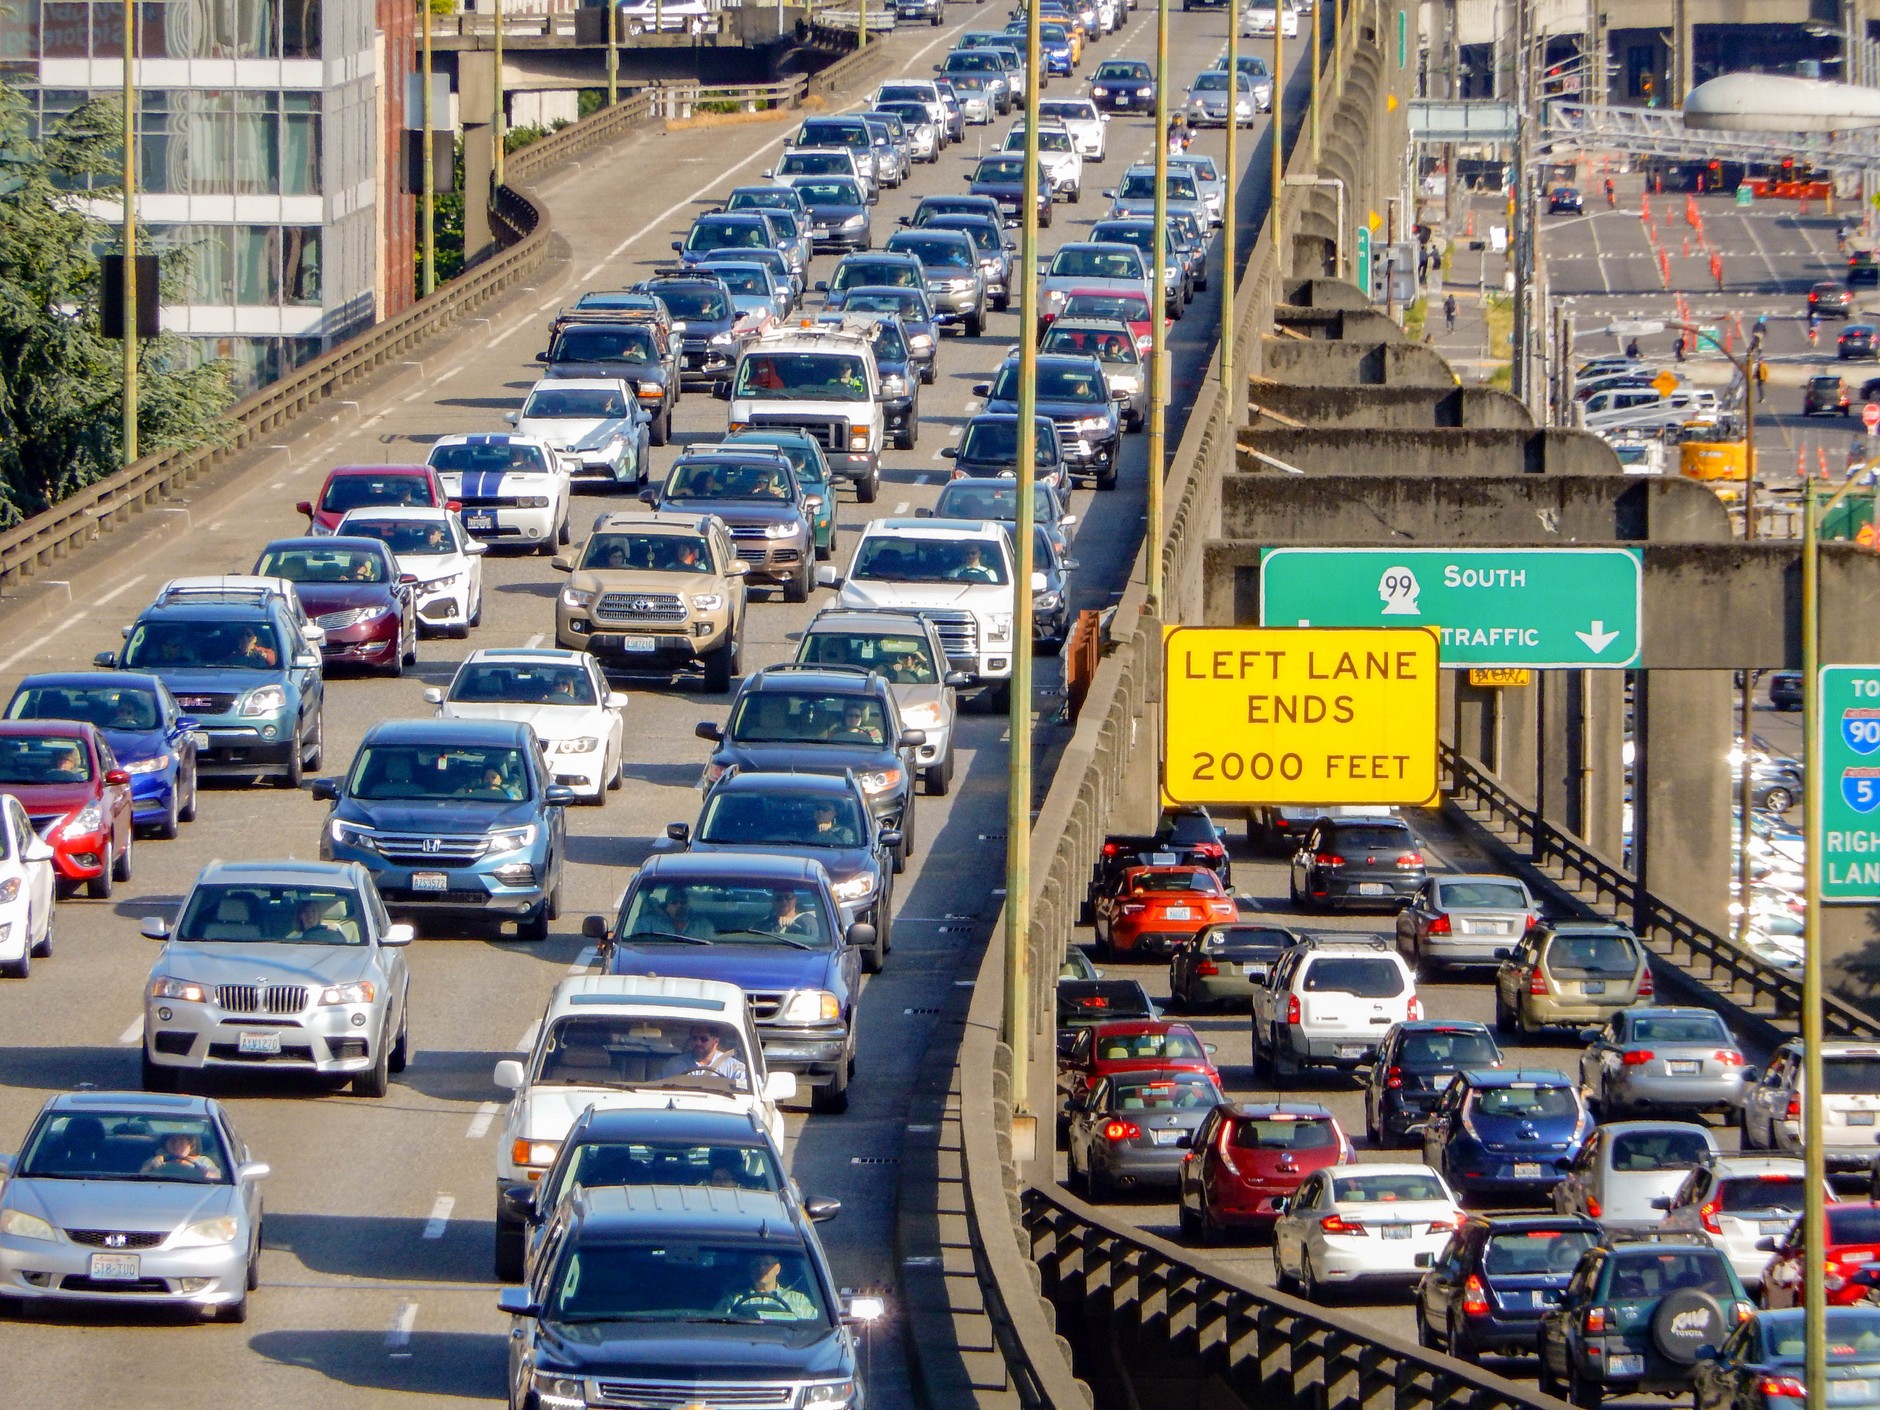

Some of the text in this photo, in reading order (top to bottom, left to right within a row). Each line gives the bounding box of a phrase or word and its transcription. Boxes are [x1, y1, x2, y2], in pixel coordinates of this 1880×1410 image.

[1385, 565, 1526, 598] 99 SOUTH
[1440, 628, 1539, 647] TRAFFIC
[1185, 651, 1417, 680] LEFT LANE
[1851, 679, 1880, 697] TO
[1248, 695, 1354, 723] ENDS
[1849, 721, 1880, 743] 90
[1192, 752, 1410, 780] 2000 FEET
[1857, 781, 1873, 803] 5
